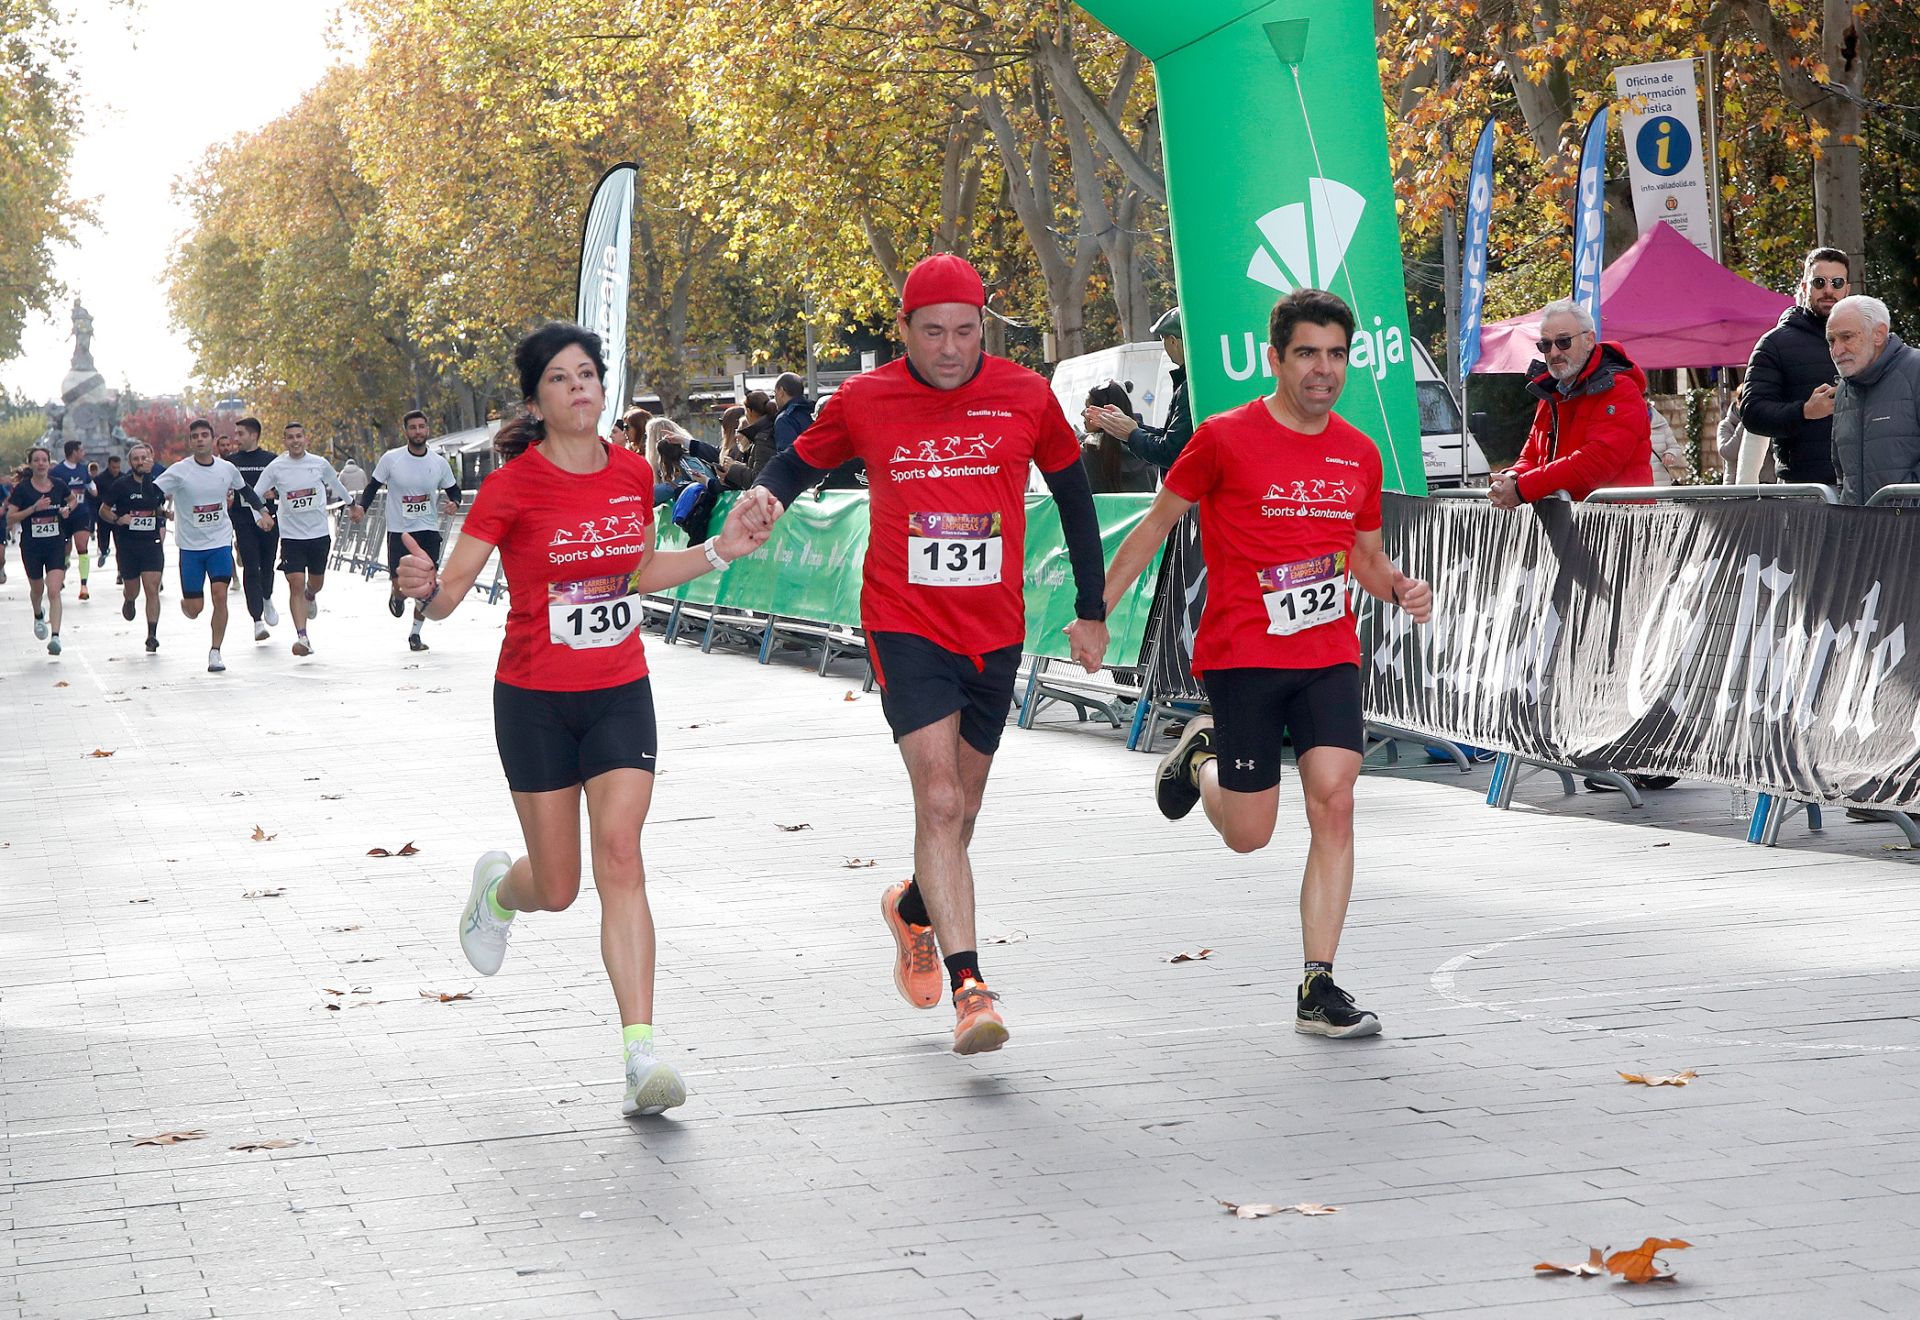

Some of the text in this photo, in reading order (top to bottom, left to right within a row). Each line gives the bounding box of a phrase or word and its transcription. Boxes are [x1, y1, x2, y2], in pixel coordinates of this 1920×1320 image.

[1626, 74, 1673, 87] Oficina de
[1640, 180, 1696, 192] info.valladolid.es
[1220, 314, 1404, 381] Uaja
[967, 409, 991, 417] Castilla
[890, 465, 1000, 482] Sports Santander
[292, 498, 313, 508] 297
[406, 503, 426, 513] 296
[198, 512, 219, 522] 295
[1261, 505, 1354, 520] Sports Santander
[133, 518, 152, 527] 242
[36, 524, 55, 534] 243
[548, 549, 588, 565] Sports
[923, 542, 987, 571] 131
[1291, 567, 1323, 579] EMPRESAS
[1280, 583, 1336, 621] 132
[567, 601, 631, 636] 130
